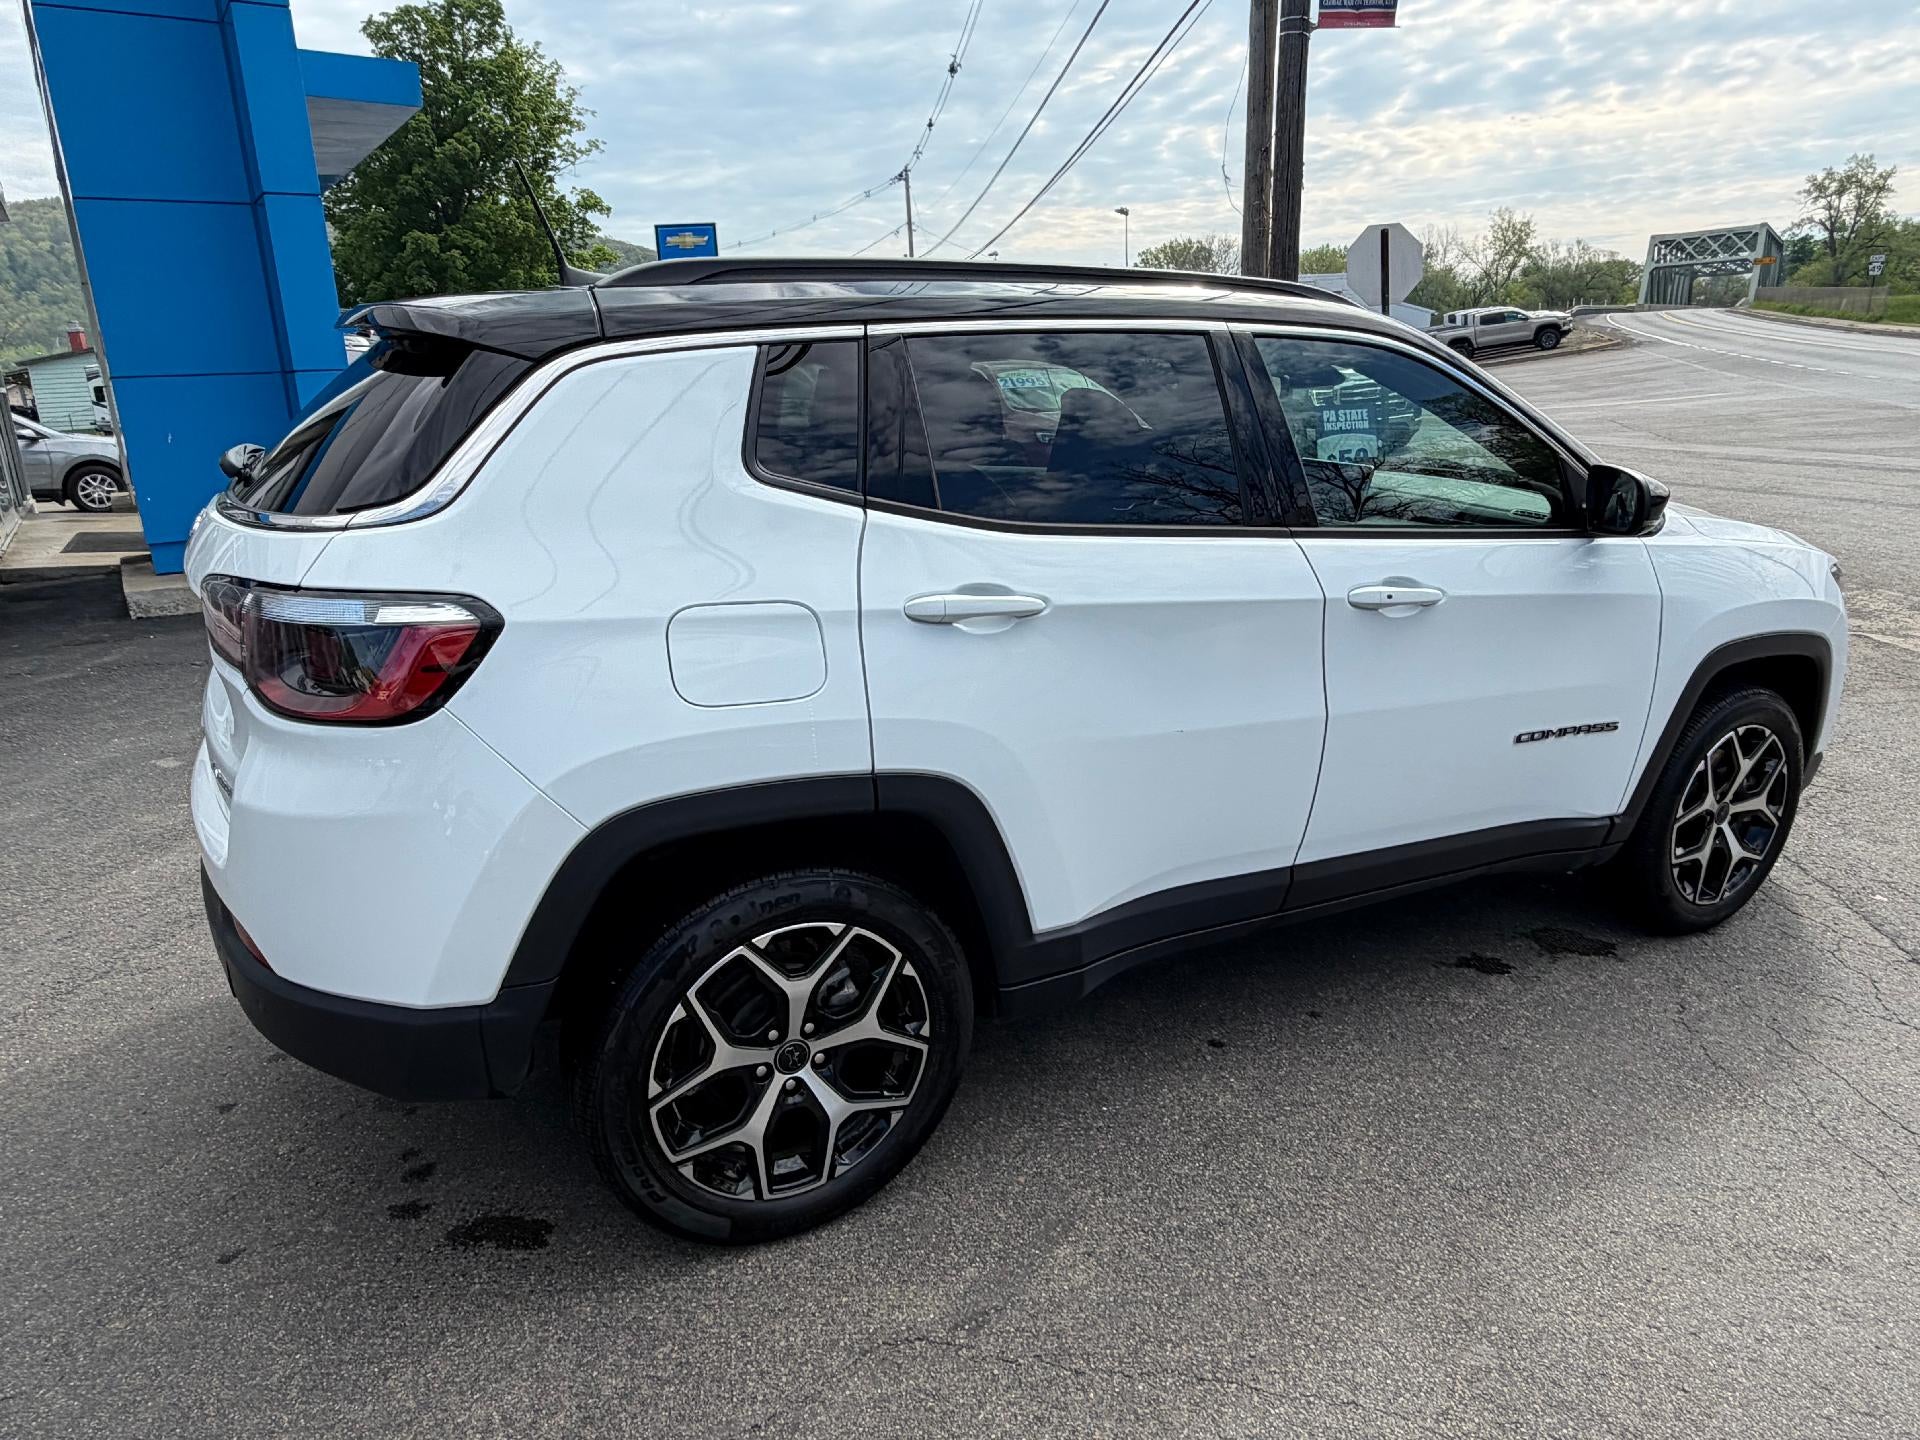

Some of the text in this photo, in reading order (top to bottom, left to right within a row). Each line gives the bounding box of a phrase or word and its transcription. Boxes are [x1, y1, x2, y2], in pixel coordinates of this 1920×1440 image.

[1323, 409, 1368, 422] PA STATE
[1324, 421, 1369, 431] INSPECTION
[1513, 721, 1619, 744] COMPASS
